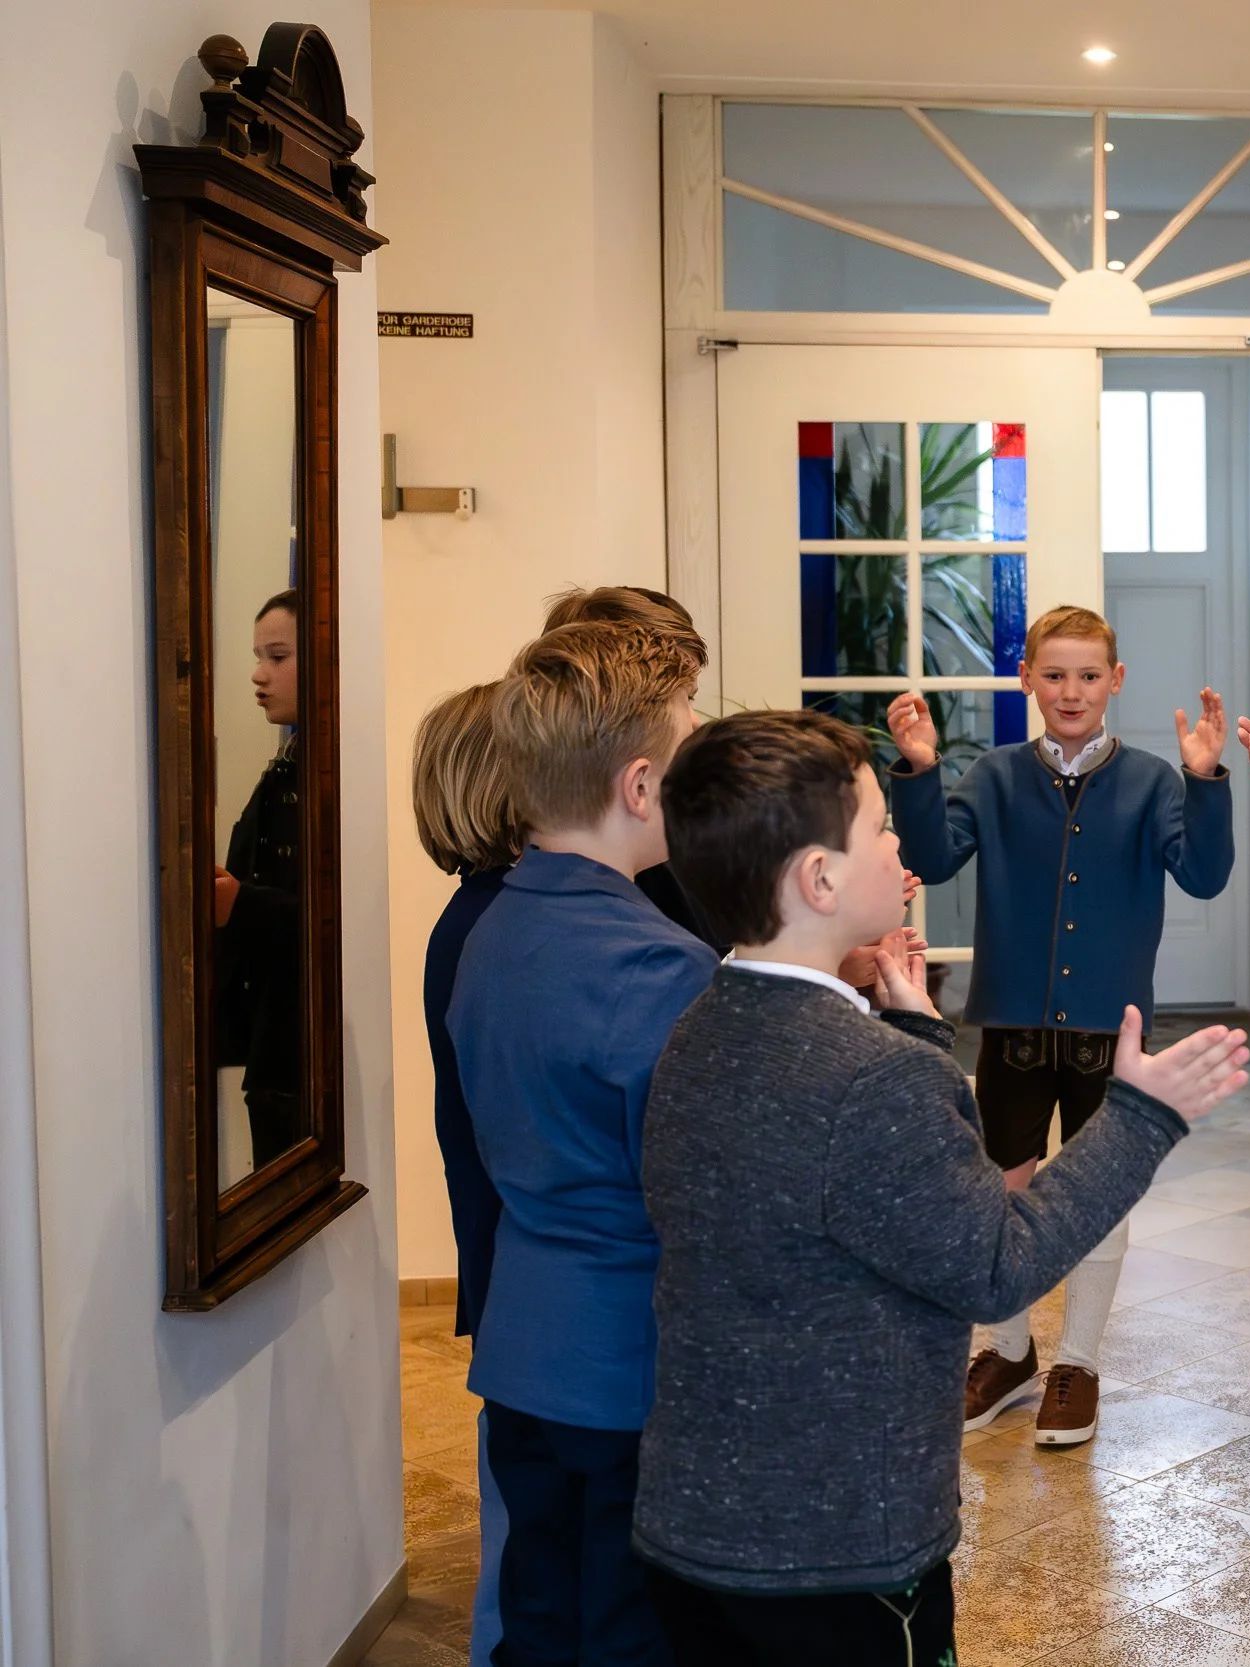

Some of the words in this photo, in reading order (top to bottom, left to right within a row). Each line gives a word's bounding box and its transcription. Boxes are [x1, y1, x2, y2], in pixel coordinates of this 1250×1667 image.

[402, 316, 471, 326] GARDEROBE
[378, 326, 411, 336] KEINE
[416, 326, 469, 337] HAFTUNG
